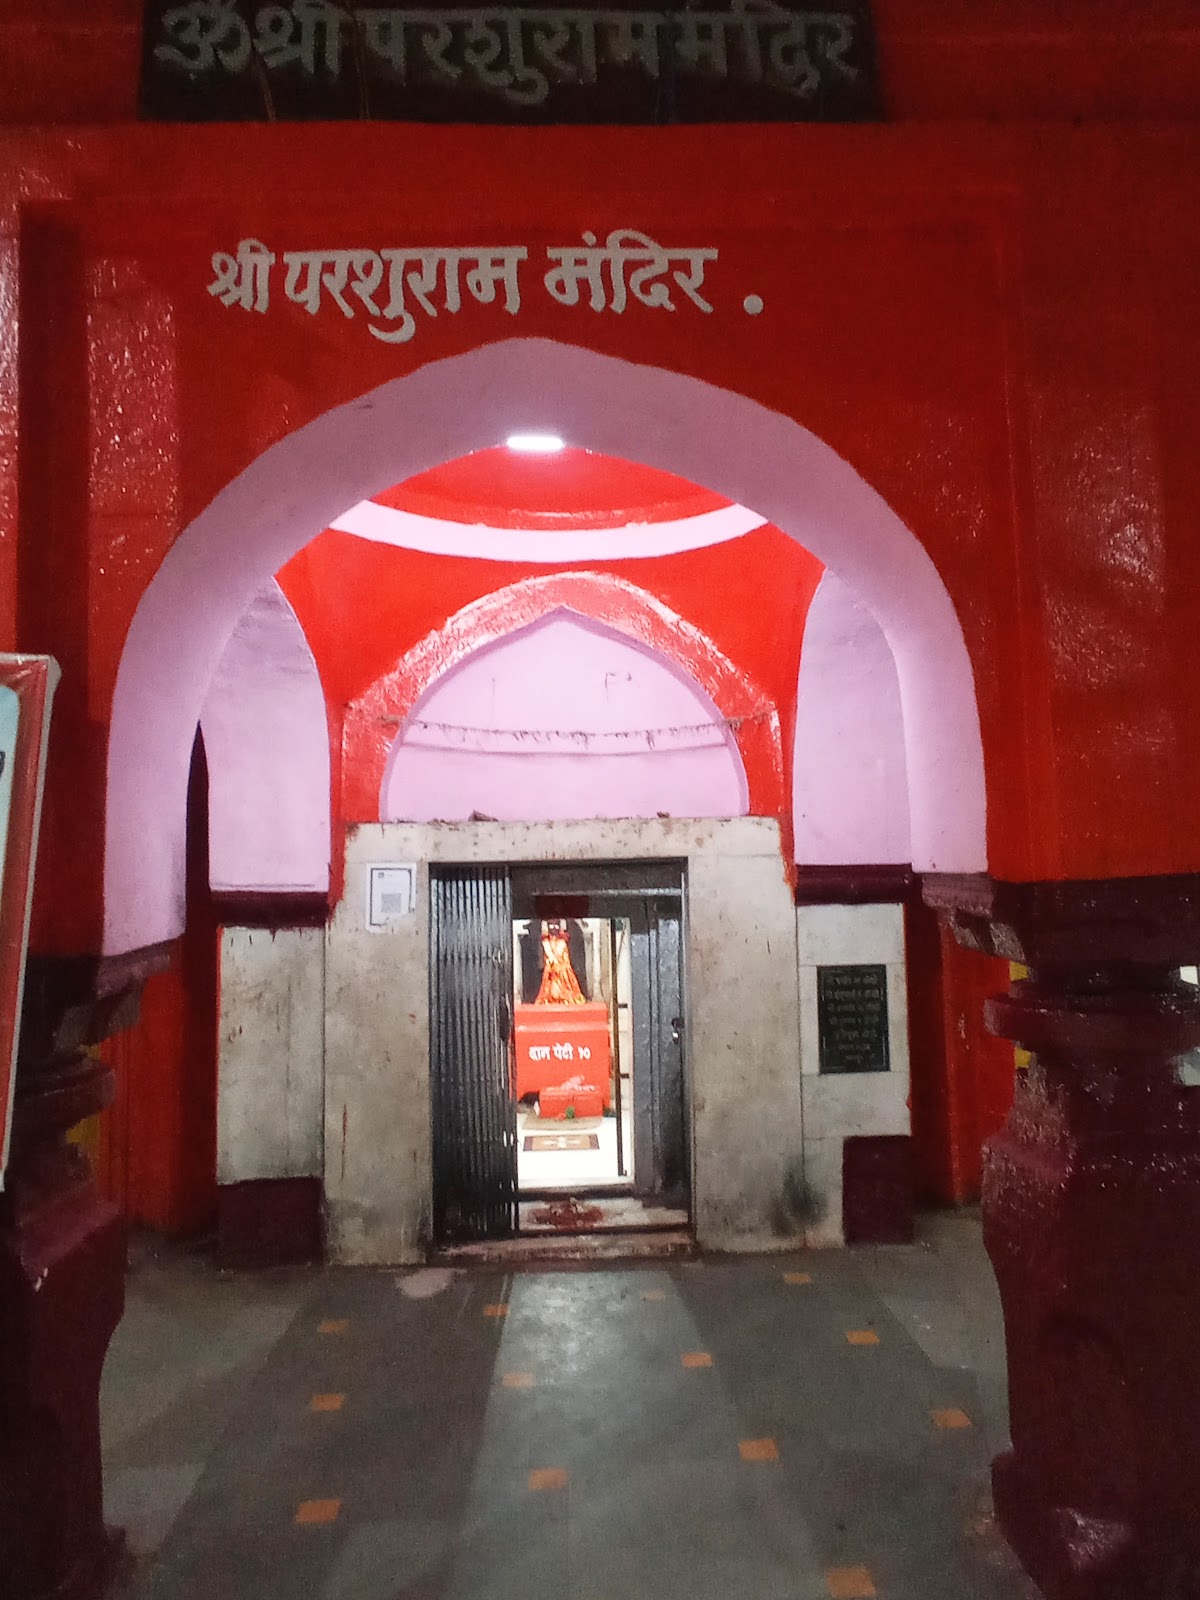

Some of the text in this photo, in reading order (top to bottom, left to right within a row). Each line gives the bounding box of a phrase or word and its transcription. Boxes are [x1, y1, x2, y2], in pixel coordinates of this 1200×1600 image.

[207, 238, 275, 314] श्री
[284, 246, 528, 343] परशुराम
[528, 1045, 551, 1061] दान
[551, 1042, 574, 1061] पेटी
